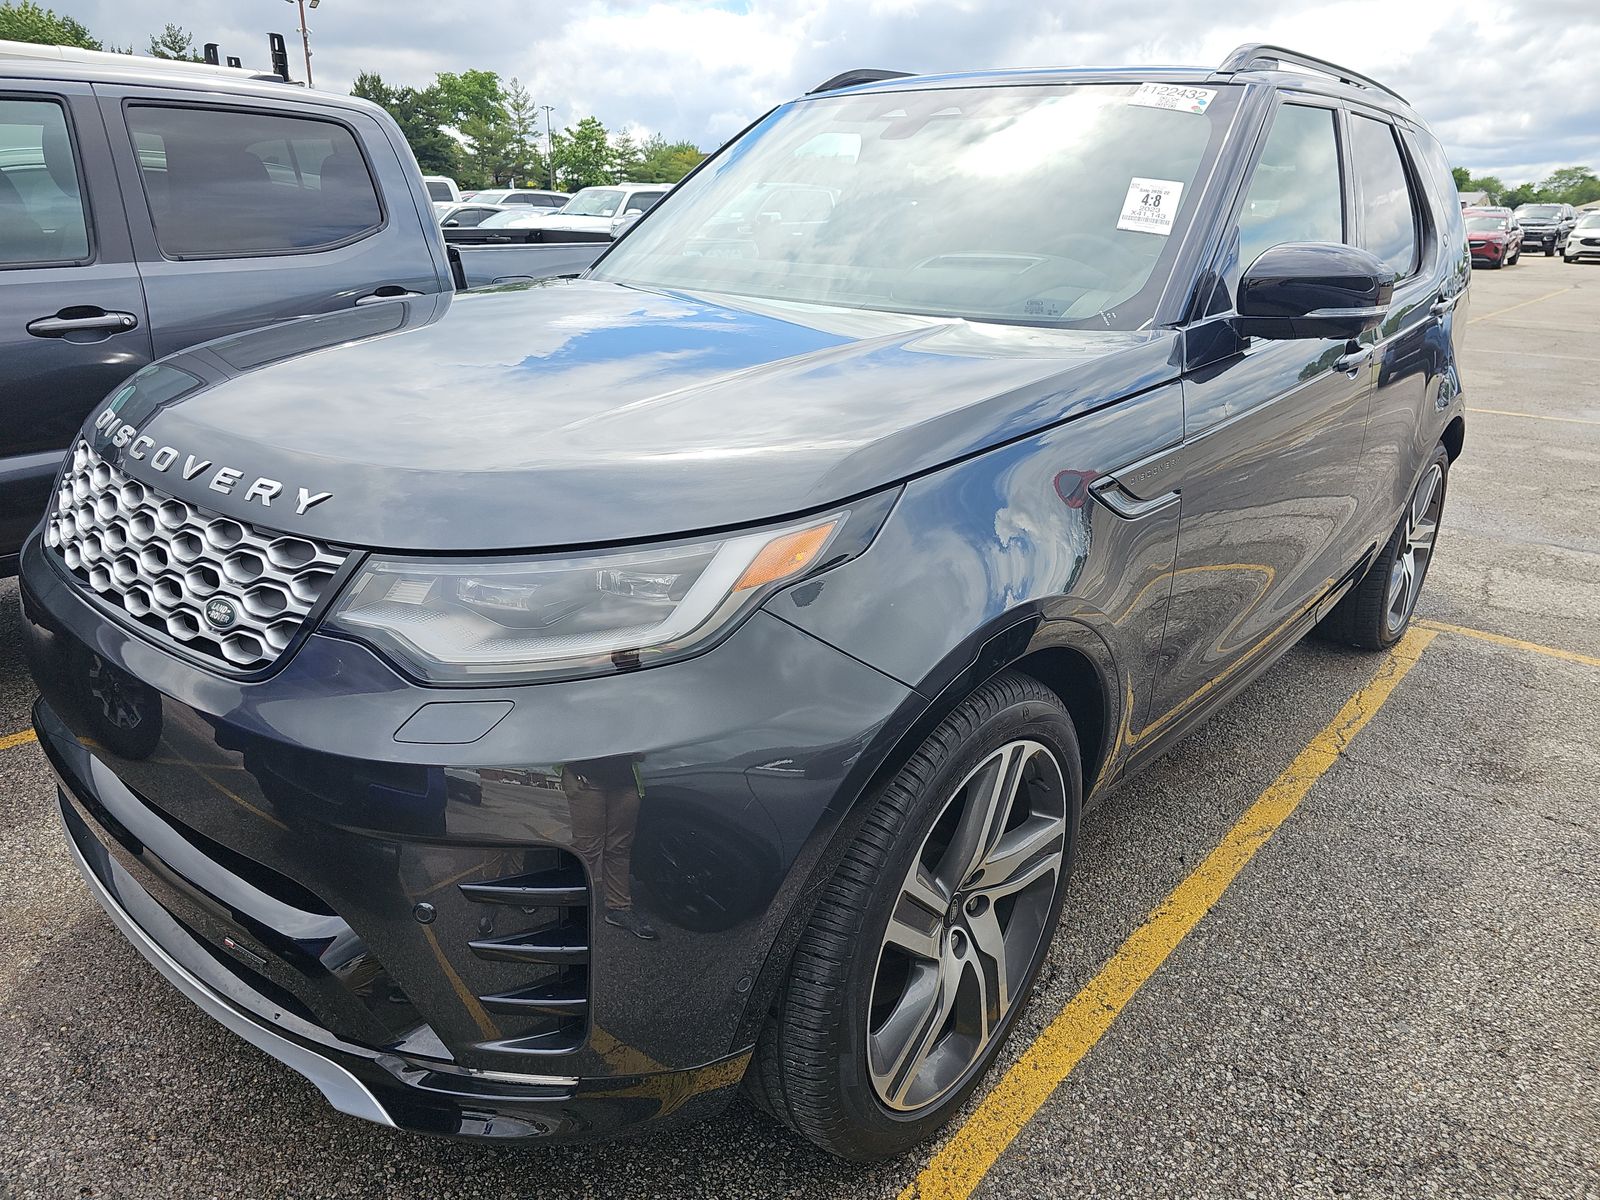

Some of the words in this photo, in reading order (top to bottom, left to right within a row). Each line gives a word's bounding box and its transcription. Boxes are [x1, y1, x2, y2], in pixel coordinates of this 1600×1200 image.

[1141, 193, 1162, 207] 4:8
[1139, 205, 1161, 213] 2023
[95, 408, 333, 515] DISCOVERY
[211, 602, 229, 613] LAND
[209, 610, 230, 623] ROVER
